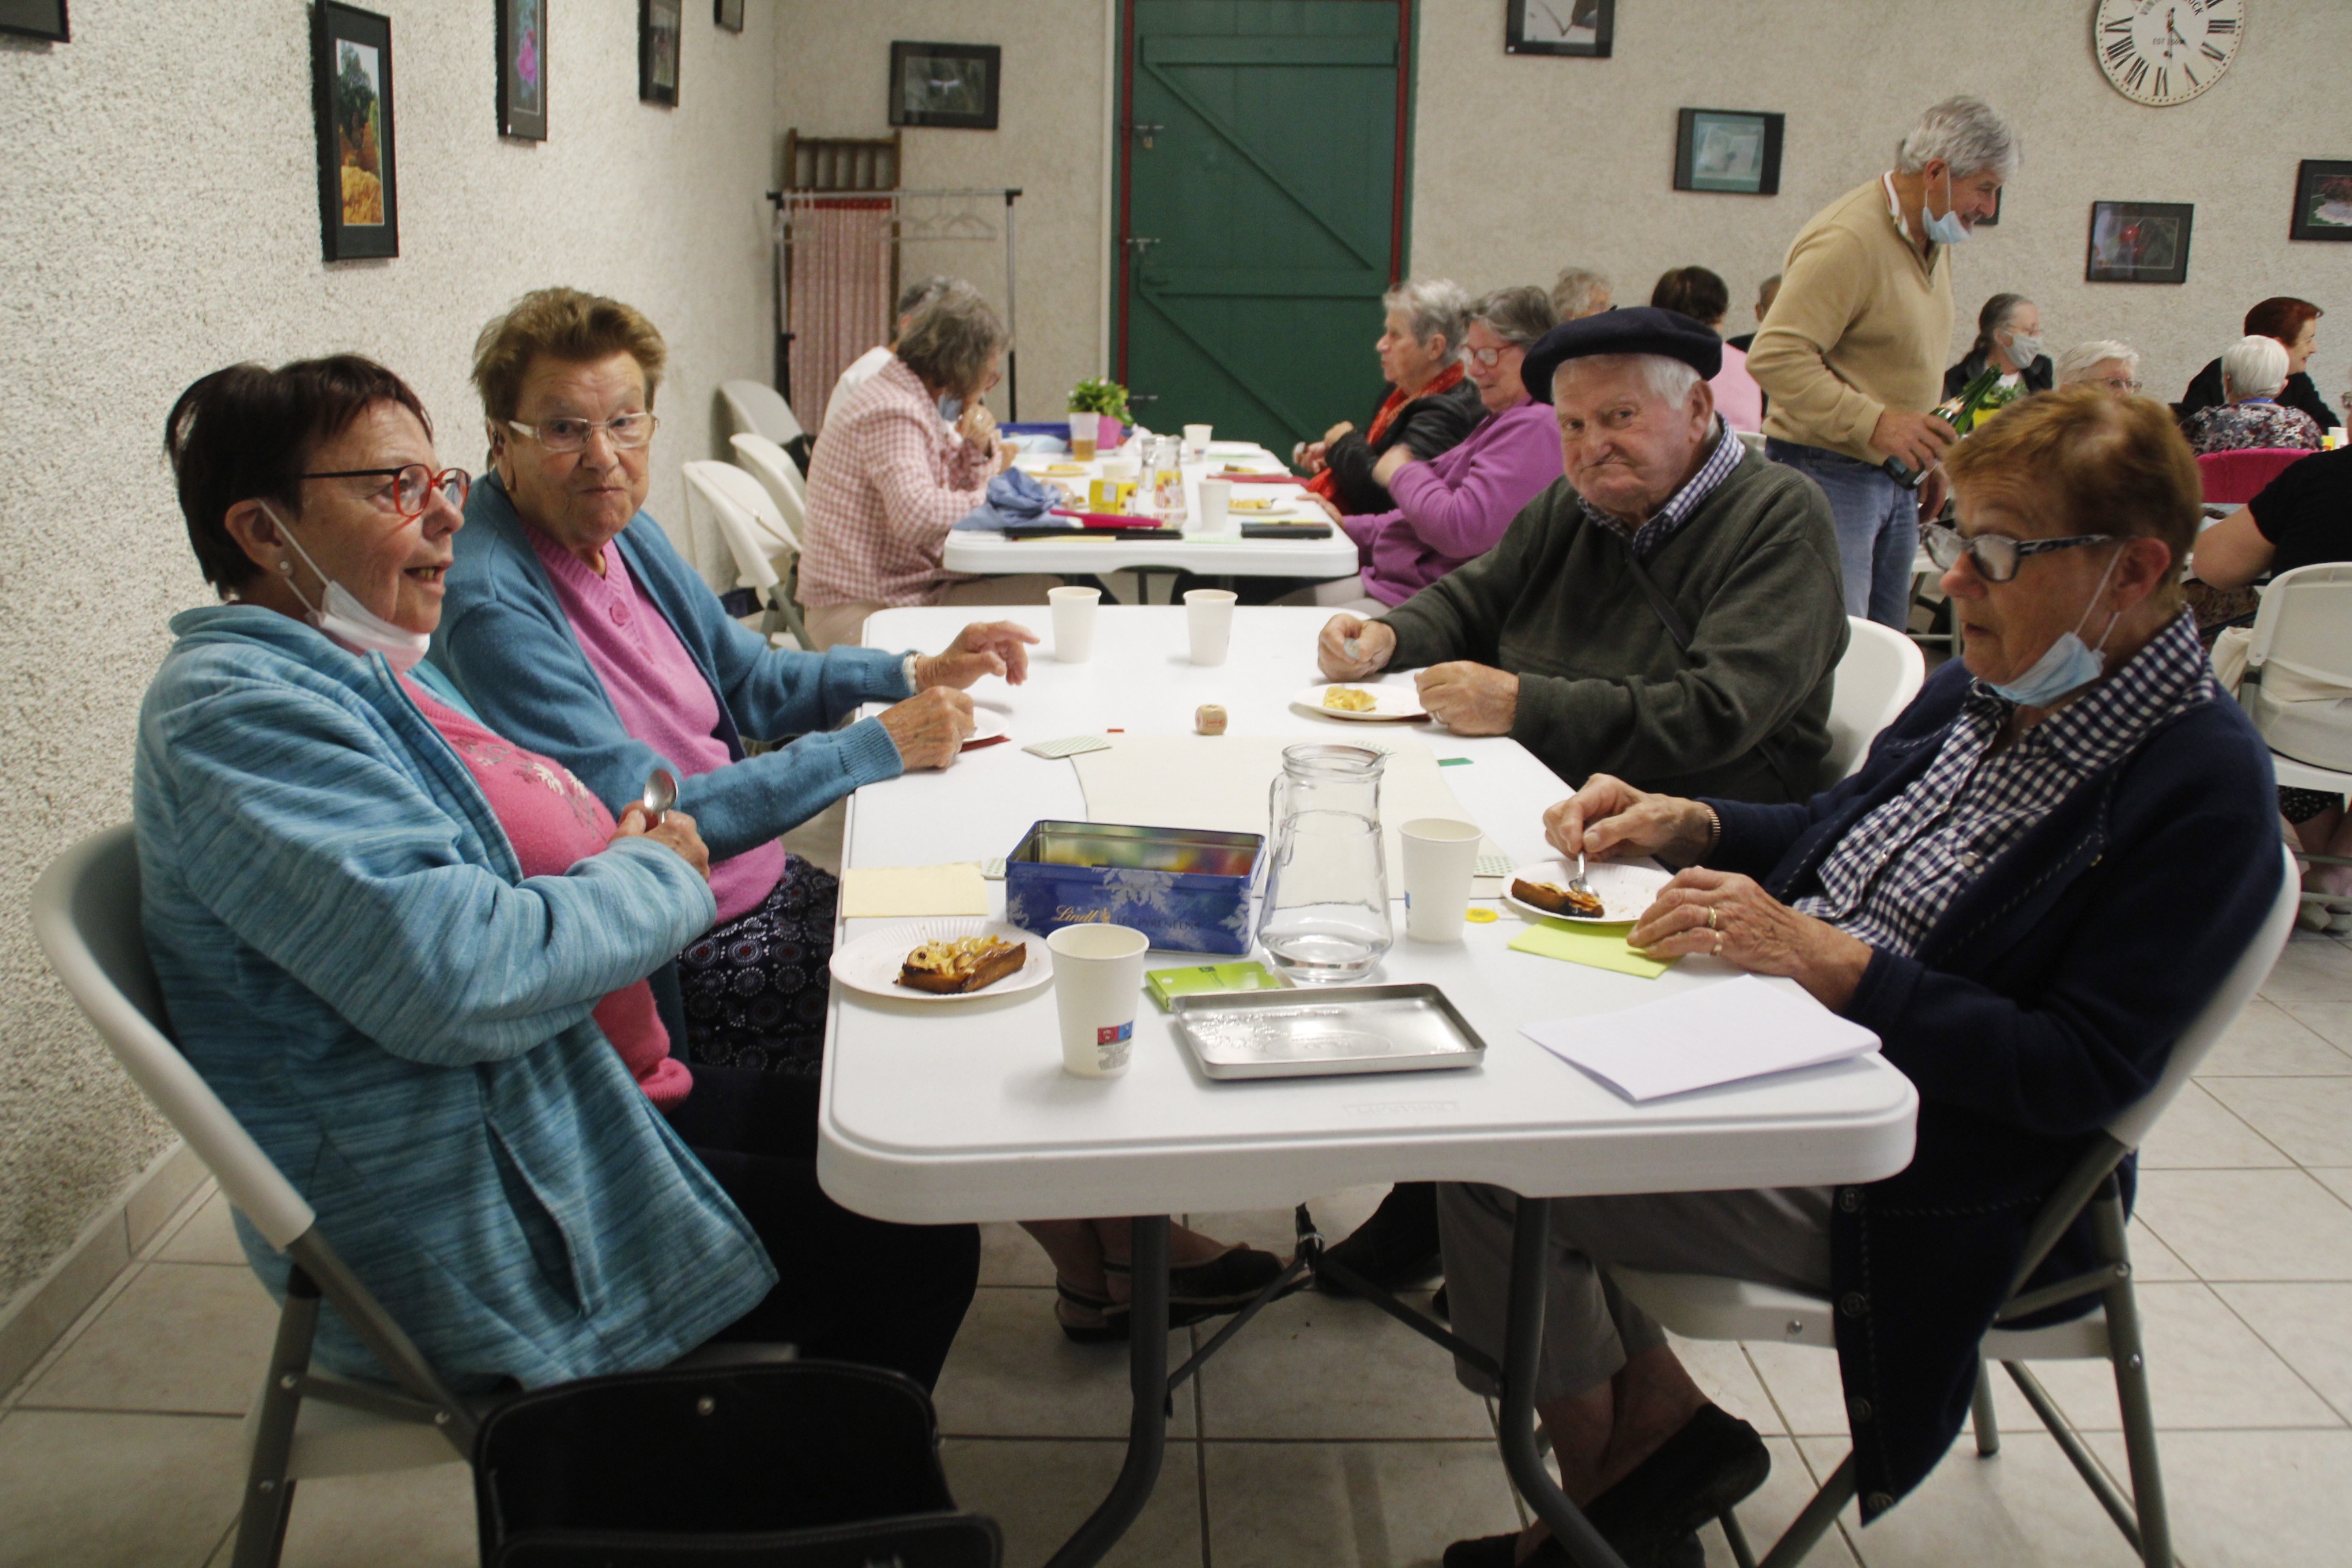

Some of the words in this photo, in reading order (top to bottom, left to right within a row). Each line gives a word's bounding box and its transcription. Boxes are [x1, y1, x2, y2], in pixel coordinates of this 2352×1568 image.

[2206, 19, 2237, 34] III
[2106, 35, 2138, 70] VIII
[2122, 56, 2151, 91] VII
[2153, 67, 2168, 96] VI
[1050, 904, 1099, 922] Lindt
